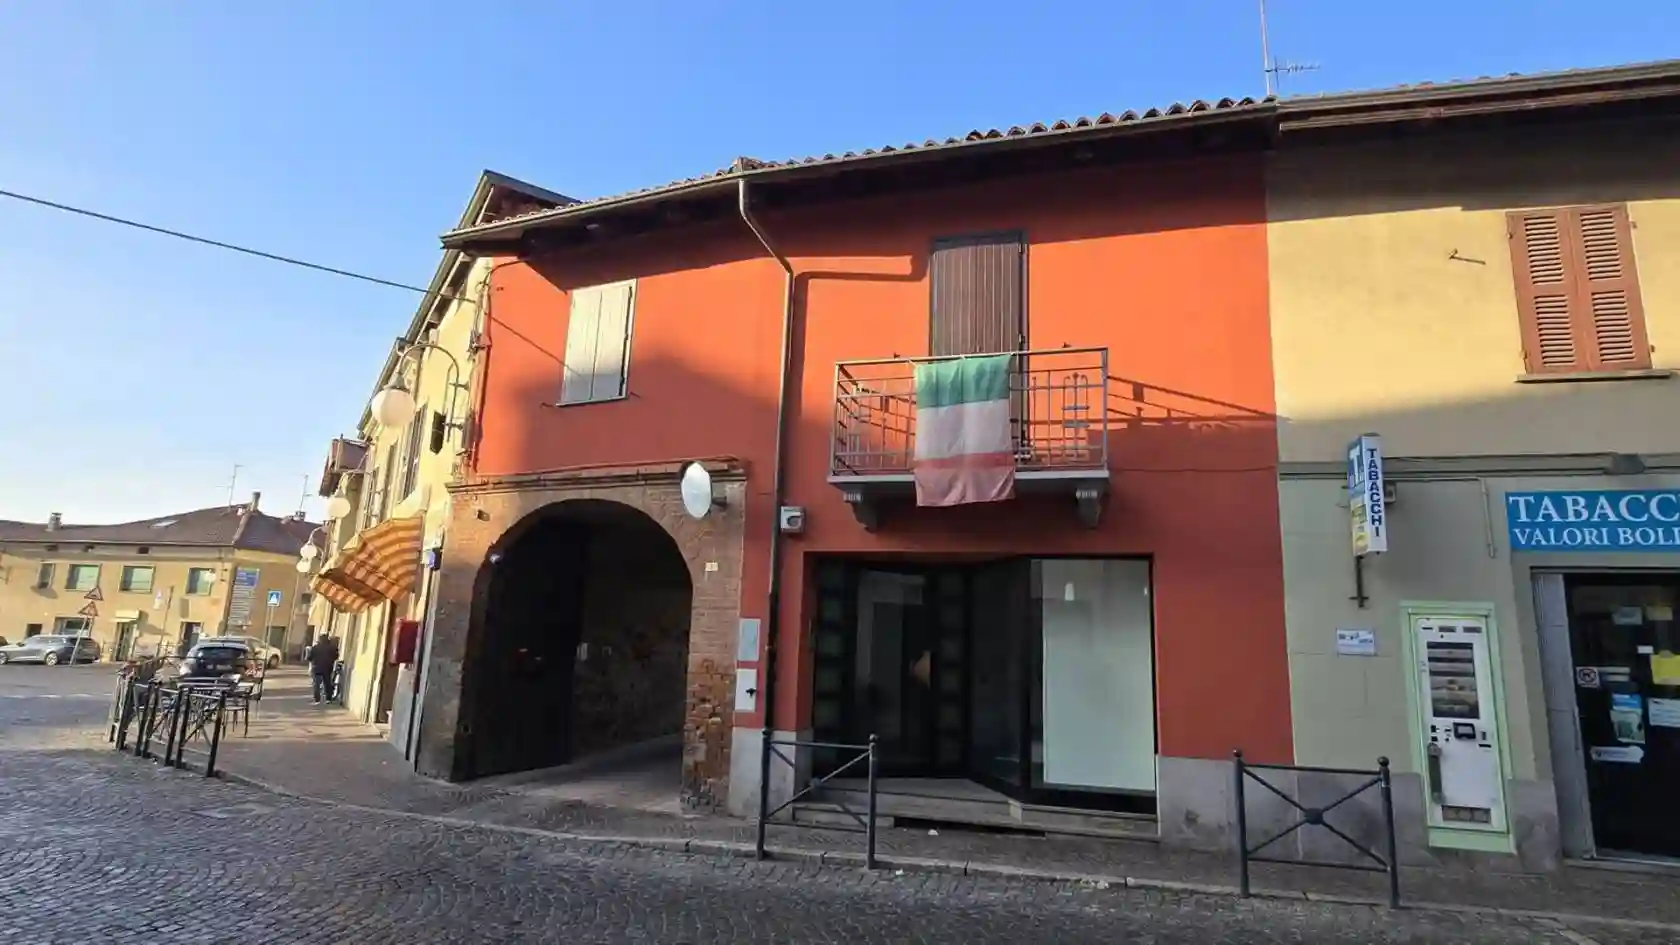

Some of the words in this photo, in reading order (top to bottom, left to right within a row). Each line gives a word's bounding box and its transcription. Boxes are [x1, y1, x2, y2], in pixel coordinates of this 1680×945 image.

[1366, 448, 1382, 537] TABACCHI
[1508, 493, 1680, 523] TABACC
[1512, 527, 1611, 546] VALORI
